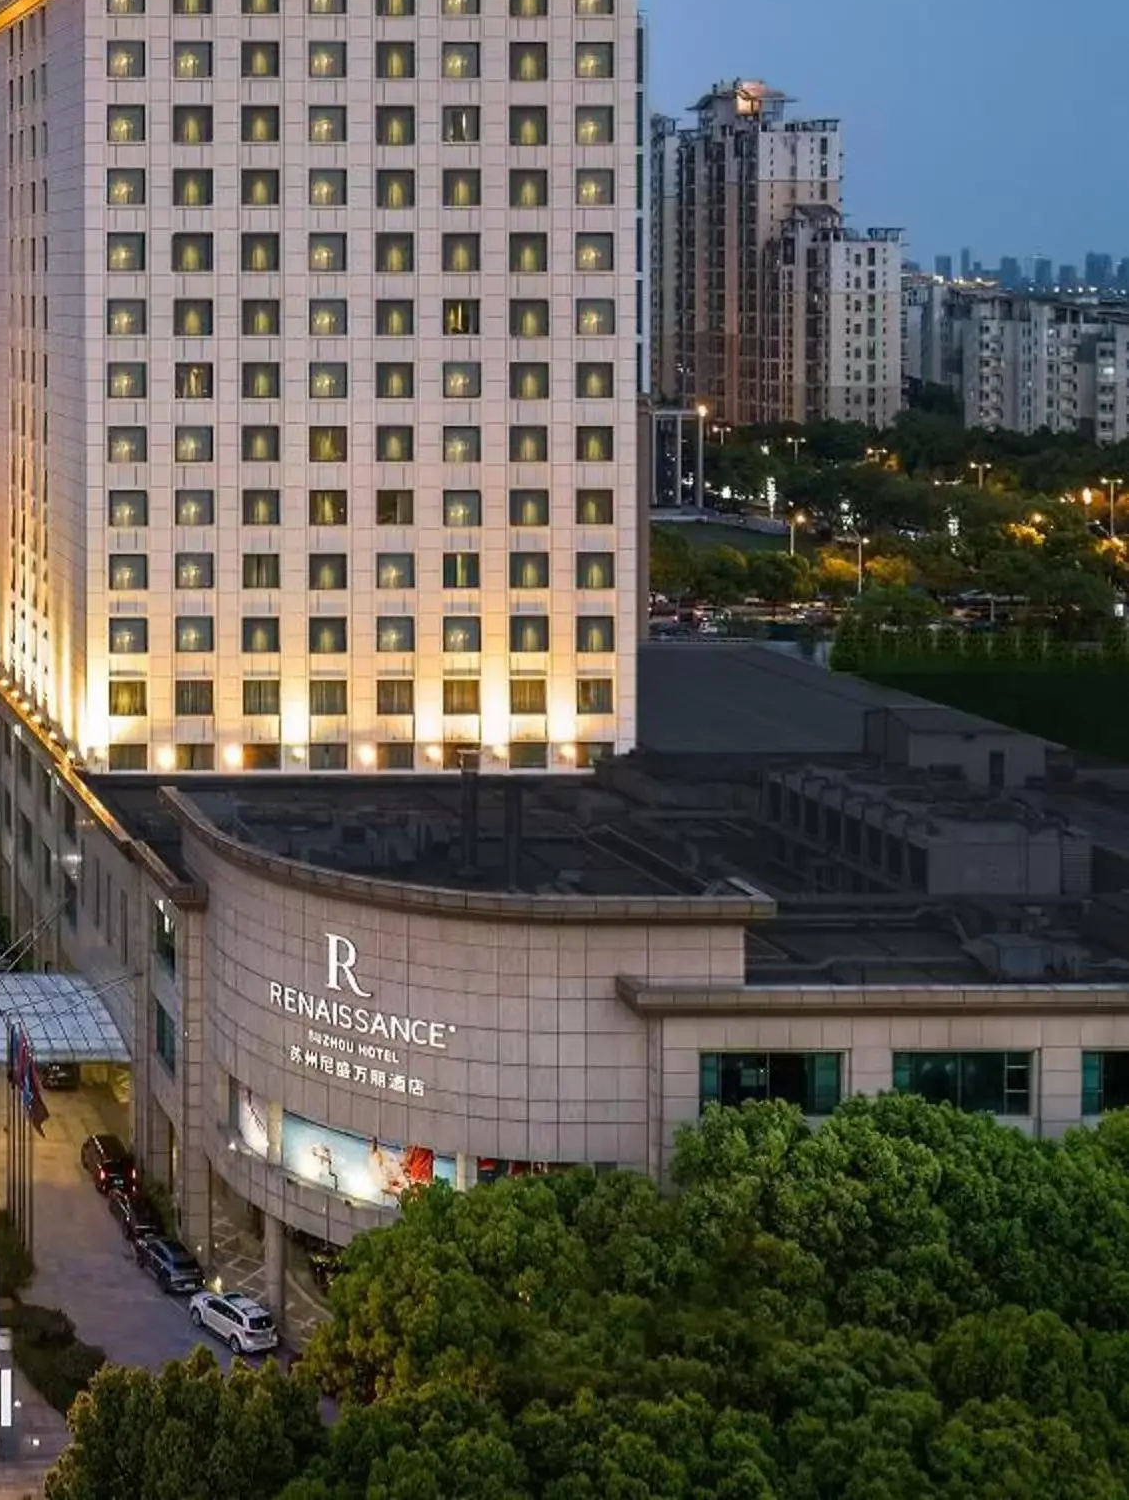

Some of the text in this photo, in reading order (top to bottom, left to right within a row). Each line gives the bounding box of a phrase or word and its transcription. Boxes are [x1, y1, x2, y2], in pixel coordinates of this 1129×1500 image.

[325, 932, 372, 998] R
[270, 982, 447, 1049] RENAISSANCE
[308, 1029, 400, 1064] SUZHOU HOTEL
